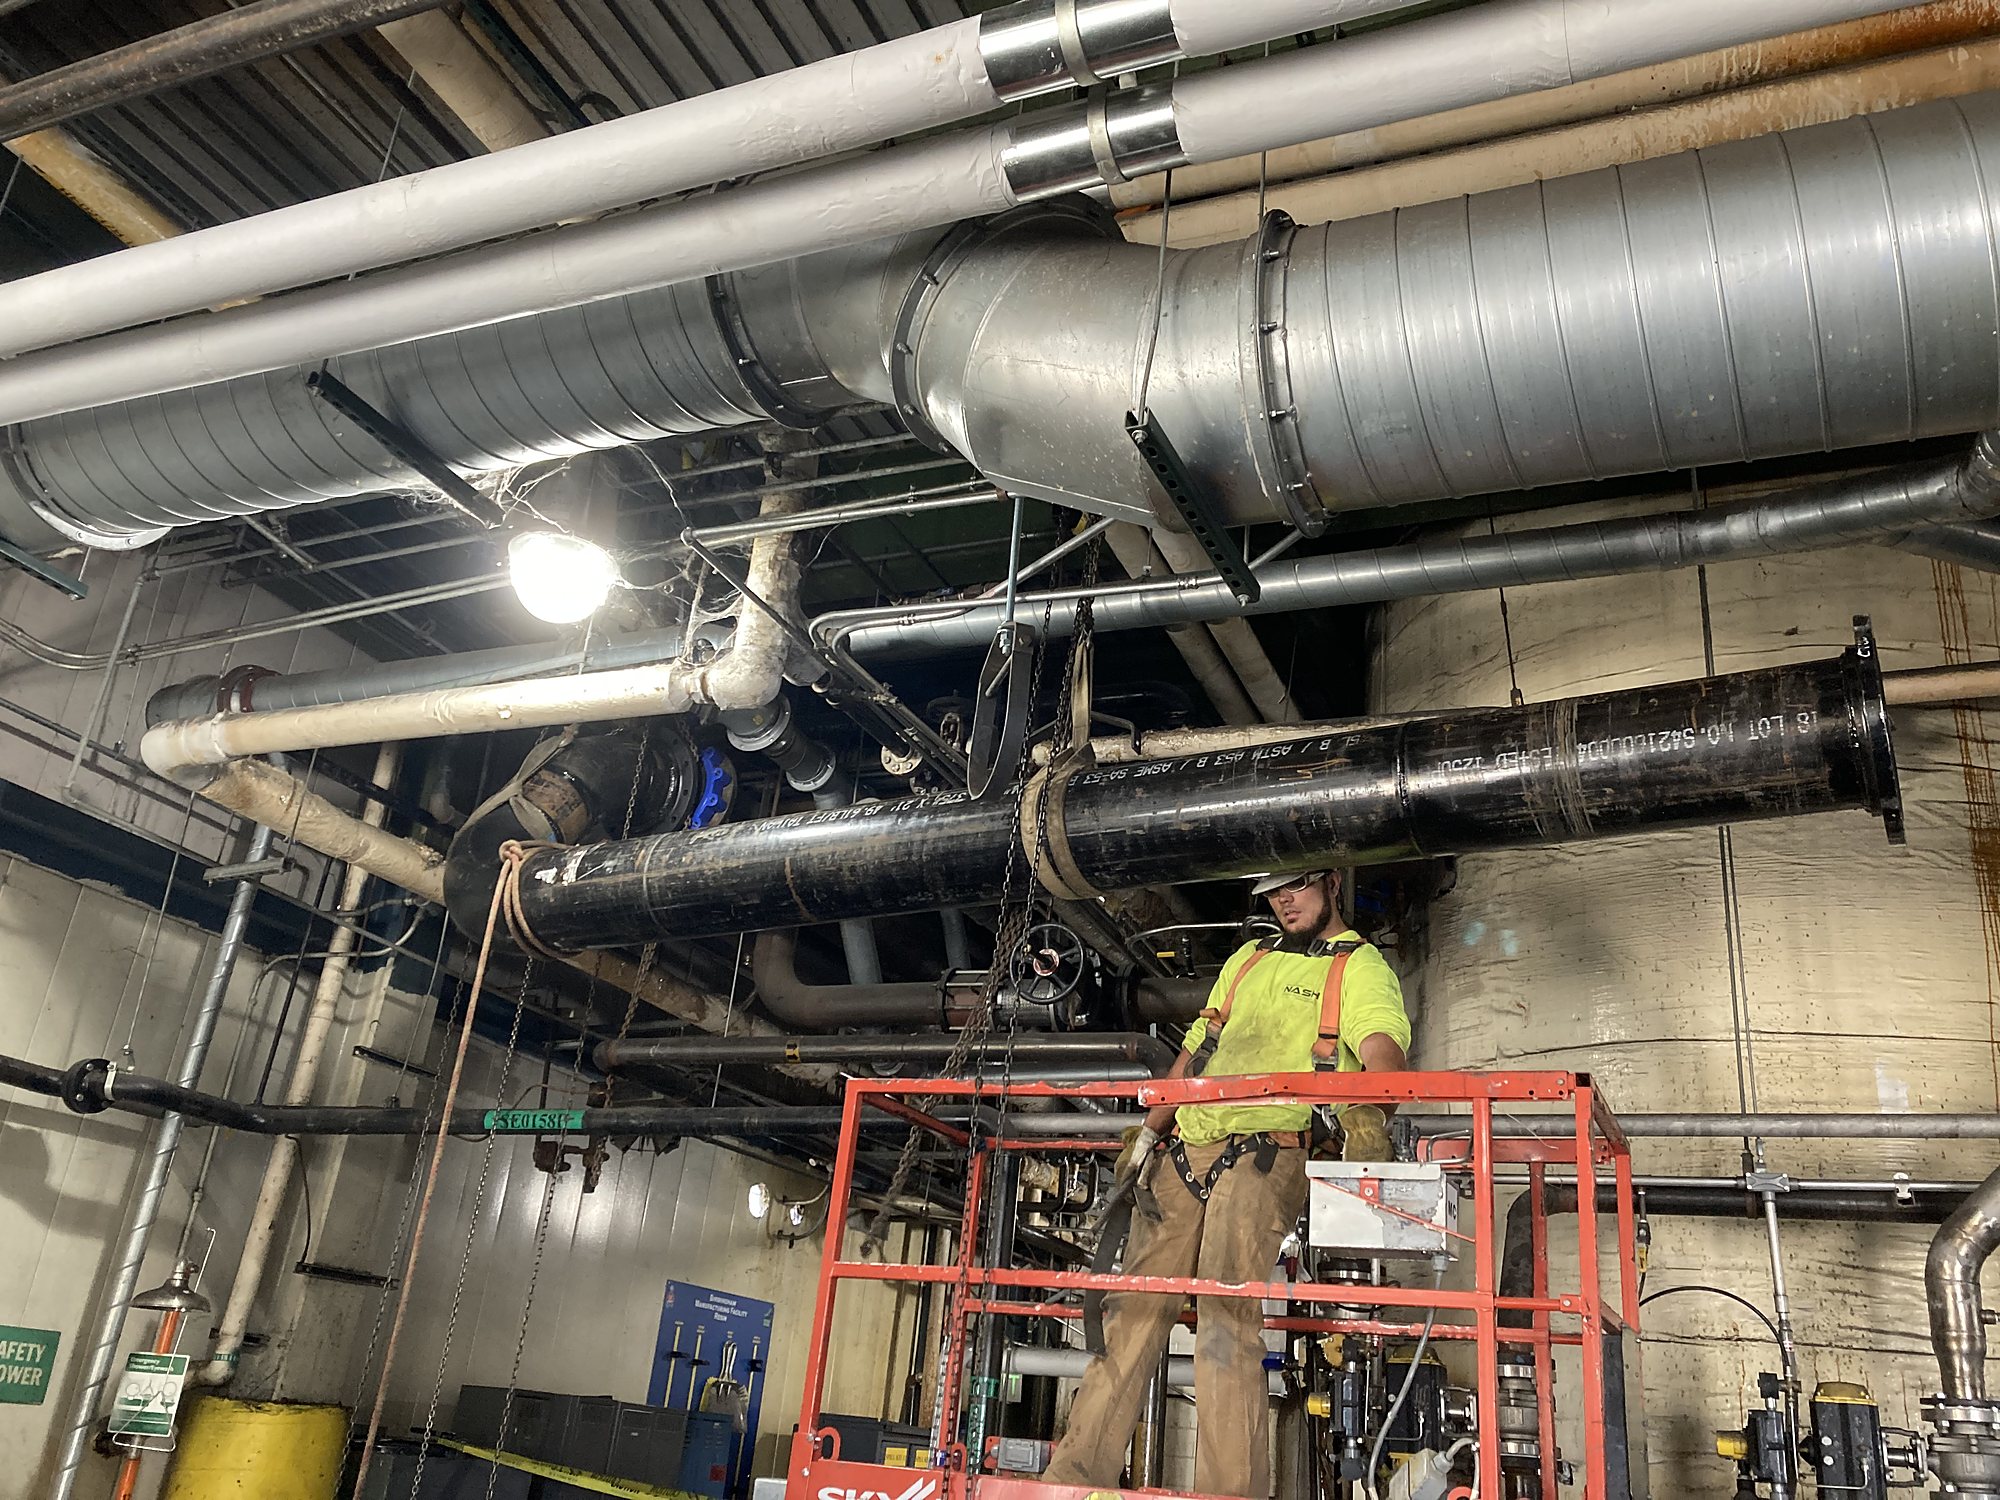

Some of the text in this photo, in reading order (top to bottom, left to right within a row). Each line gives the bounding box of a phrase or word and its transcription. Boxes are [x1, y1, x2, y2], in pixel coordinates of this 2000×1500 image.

[1749, 715, 1785, 741] LOT
[1252, 743, 1293, 760] ASTM
[1320, 738, 1331, 751] B
[1134, 762, 1173, 778] ASME
[1197, 756, 1207, 768] B
[1082, 768, 1127, 785] SA-53
[1284, 986, 1320, 1000] NASH
